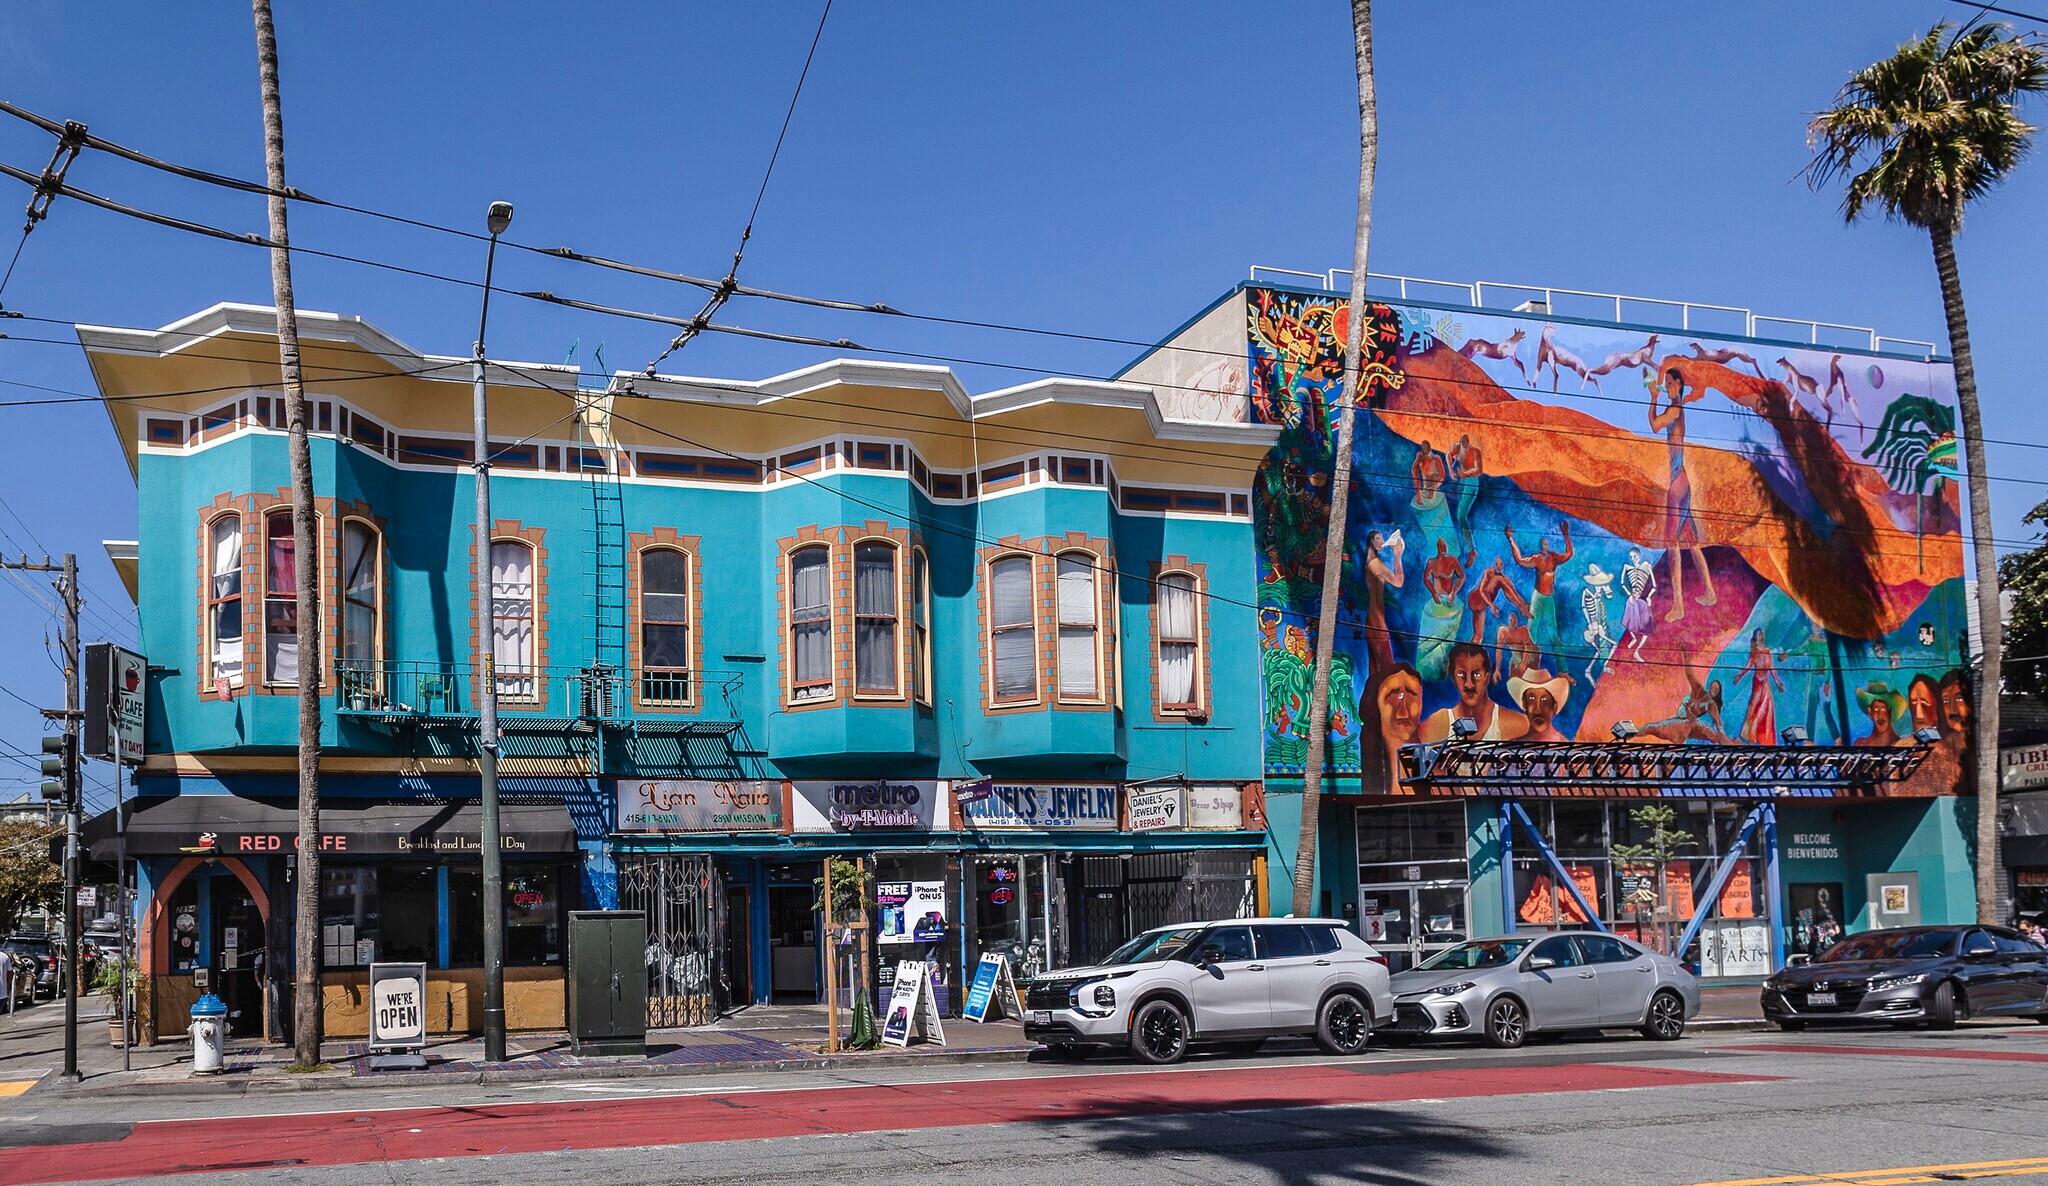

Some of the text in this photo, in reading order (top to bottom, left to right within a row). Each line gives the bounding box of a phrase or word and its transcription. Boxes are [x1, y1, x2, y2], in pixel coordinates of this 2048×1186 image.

[125, 698, 143, 718] CAFE
[108, 735, 143, 755] OPN 7 DAYS
[713, 782, 771, 809] Nails
[832, 779, 921, 805] metro
[1047, 786, 1116, 819] JEWELRY
[1132, 794, 1163, 808] DANIEL'S
[1212, 797, 1234, 814] Shop
[733, 813, 766, 823] MISSION
[768, 813, 778, 822] ST
[1133, 805, 1162, 818] JEWELRY
[840, 809, 919, 830] by T-Mobile
[1133, 817, 1166, 830] & REPAIRS
[239, 836, 347, 850] RED FE
[399, 837, 440, 849] Breakfast
[441, 837, 458, 849] and
[461, 837, 484, 849] Lunc
[506, 837, 526, 850] Day
[1793, 834, 1831, 844] WELCOME
[1788, 848, 1838, 859] BIENVENIDOS
[877, 885, 909, 896] FREE
[992, 890, 1013, 901] OPEN
[513, 893, 544, 905] OPEN
[1729, 930, 1763, 938] MISION
[1727, 949, 1764, 963] ARTS
[387, 992, 413, 1006] WE'RE
[381, 1006, 417, 1029] OPEN
